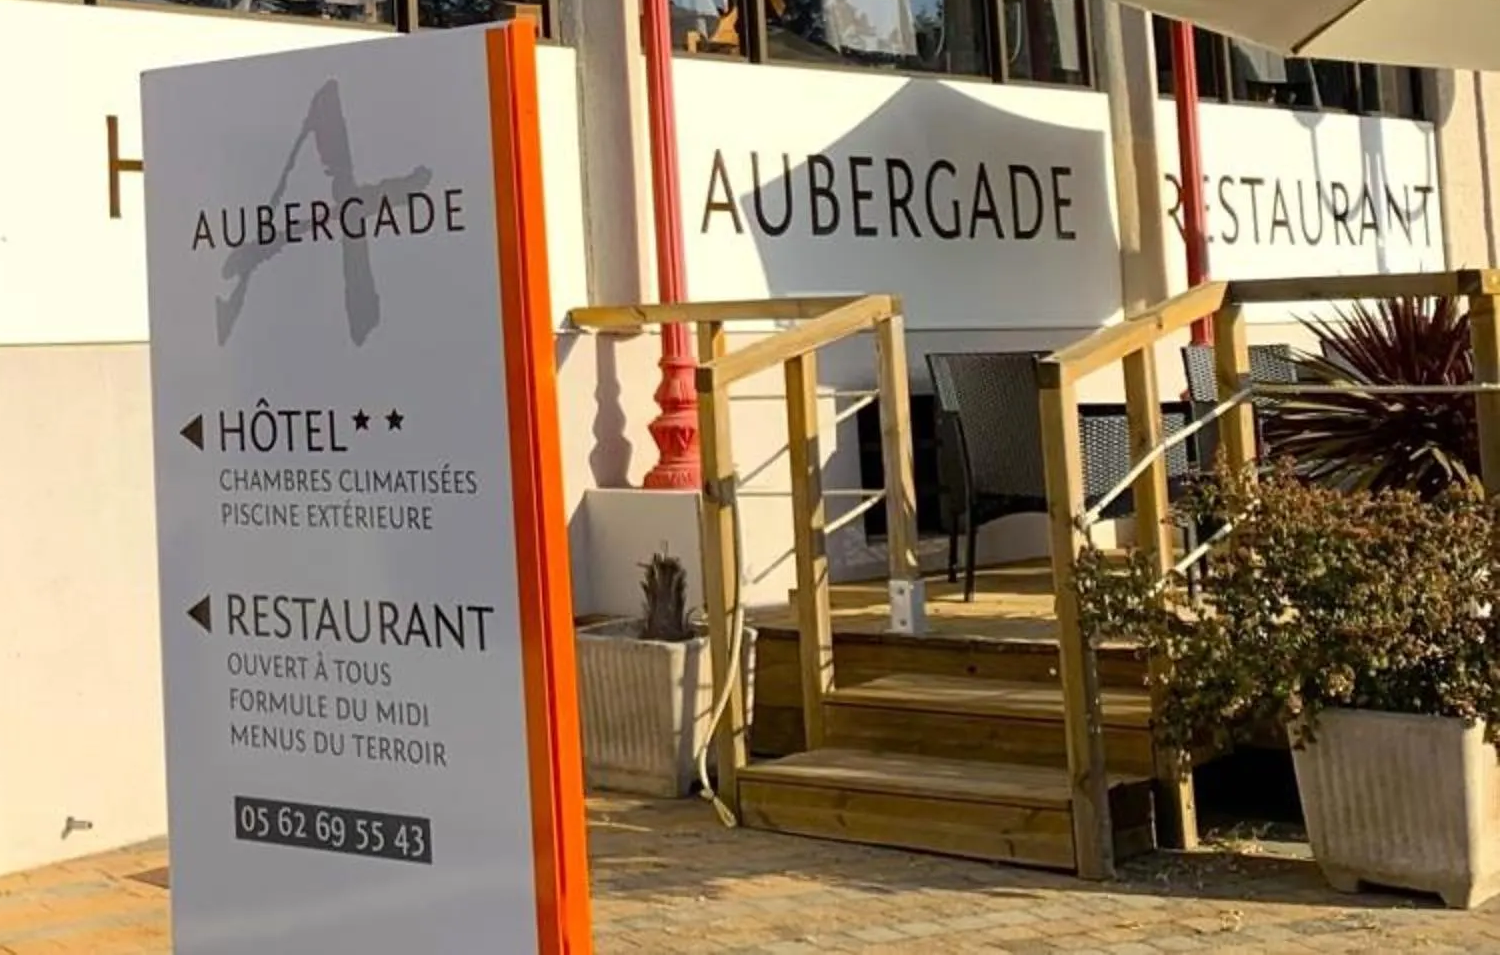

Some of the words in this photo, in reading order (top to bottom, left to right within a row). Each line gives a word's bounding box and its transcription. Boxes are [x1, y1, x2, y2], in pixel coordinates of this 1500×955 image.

[191, 188, 466, 252] AUBERGADE
[700, 147, 1078, 241] AUBERGADE
[1163, 172, 1435, 248] RSTAURANT
[219, 397, 349, 453] HÔTEL
[219, 469, 333, 494] CHAMBRES
[339, 463, 479, 495] CLIMATISÉES
[221, 501, 301, 528] PISCINE
[306, 499, 434, 531] EXTÉRIEURE
[227, 593, 496, 653] RESTAURANT
[227, 651, 308, 681] OUVERT
[313, 650, 329, 682] À
[333, 659, 393, 687] TOUS
[229, 688, 328, 719] FORMULE
[336, 696, 368, 723] DU
[376, 701, 431, 728] MIDI
[230, 723, 307, 754] MENUS
[313, 730, 346, 757] DU
[352, 733, 448, 768] TERROIR
[240, 804, 270, 838] 05
[277, 807, 308, 838] 62
[315, 811, 346, 847] 69
[355, 819, 385, 852] 55
[394, 824, 426, 858] 43
